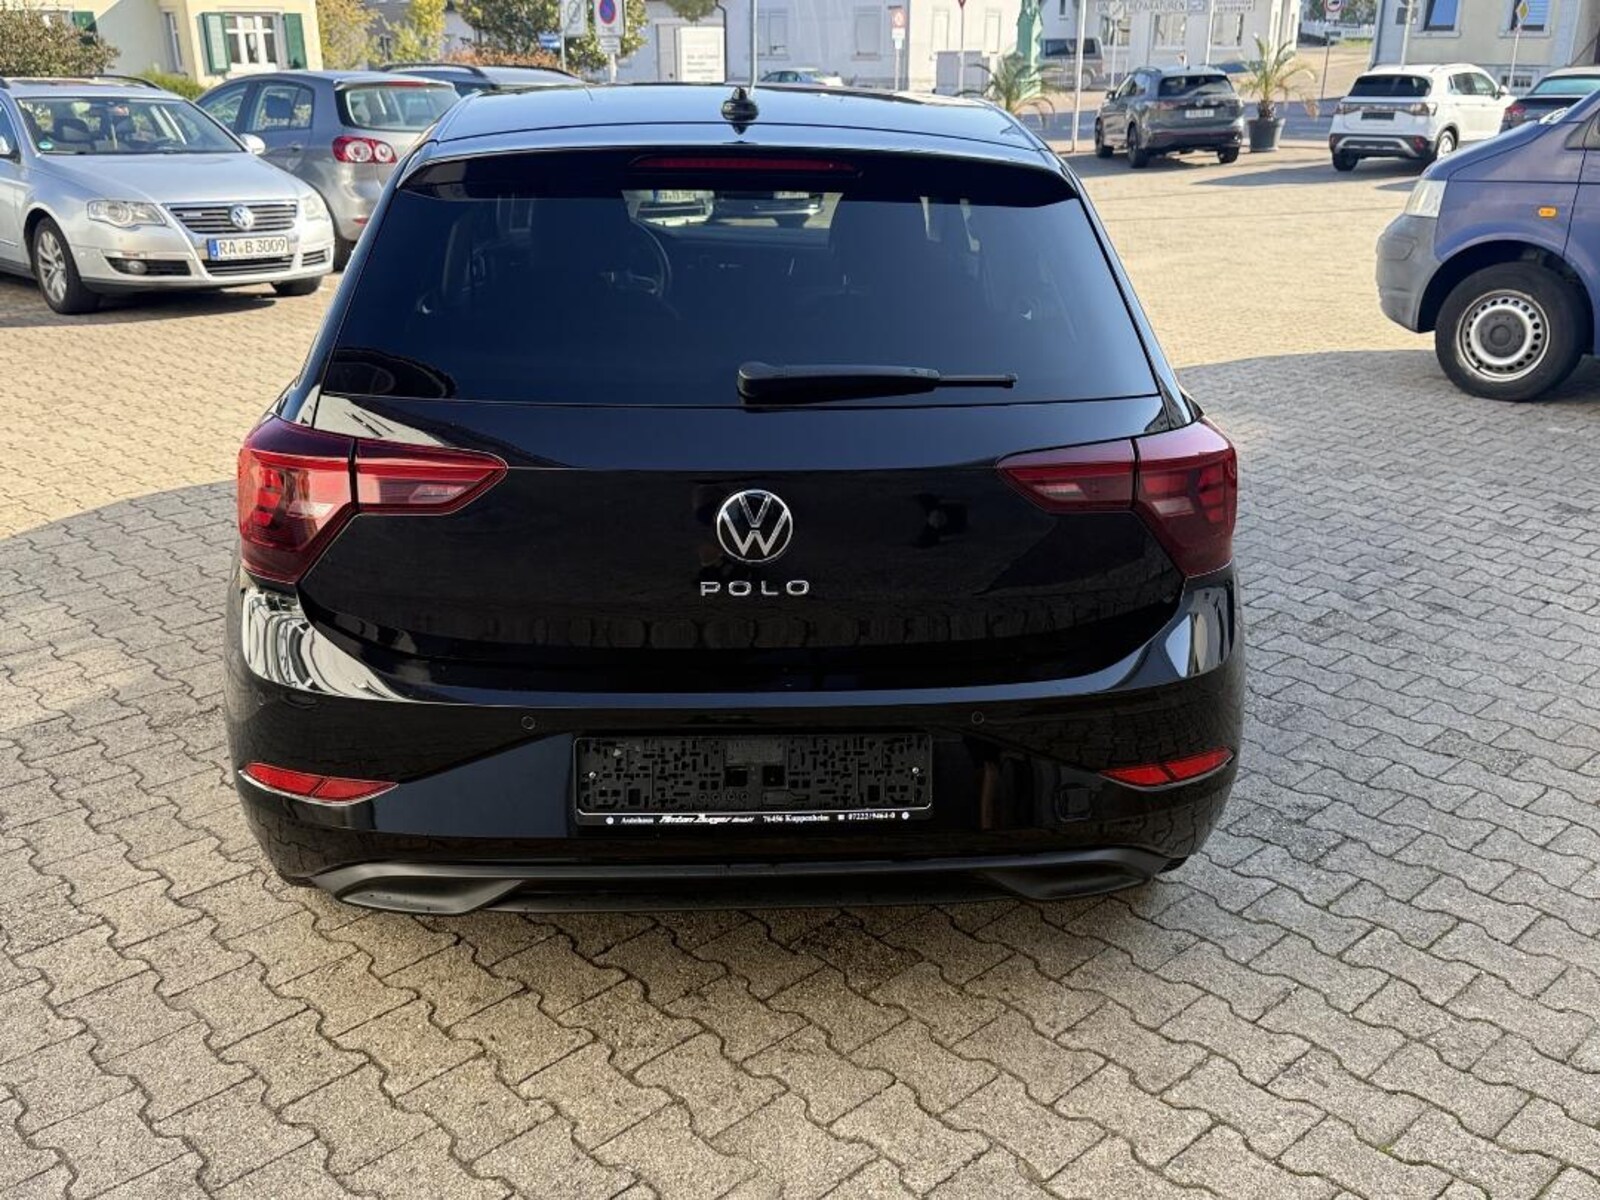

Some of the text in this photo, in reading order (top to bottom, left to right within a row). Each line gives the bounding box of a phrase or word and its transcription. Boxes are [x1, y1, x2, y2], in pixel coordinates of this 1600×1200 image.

[219, 238, 285, 255] RA B 3009
[700, 579, 810, 597] POLO
[784, 814, 830, 824] Kuppenheim
